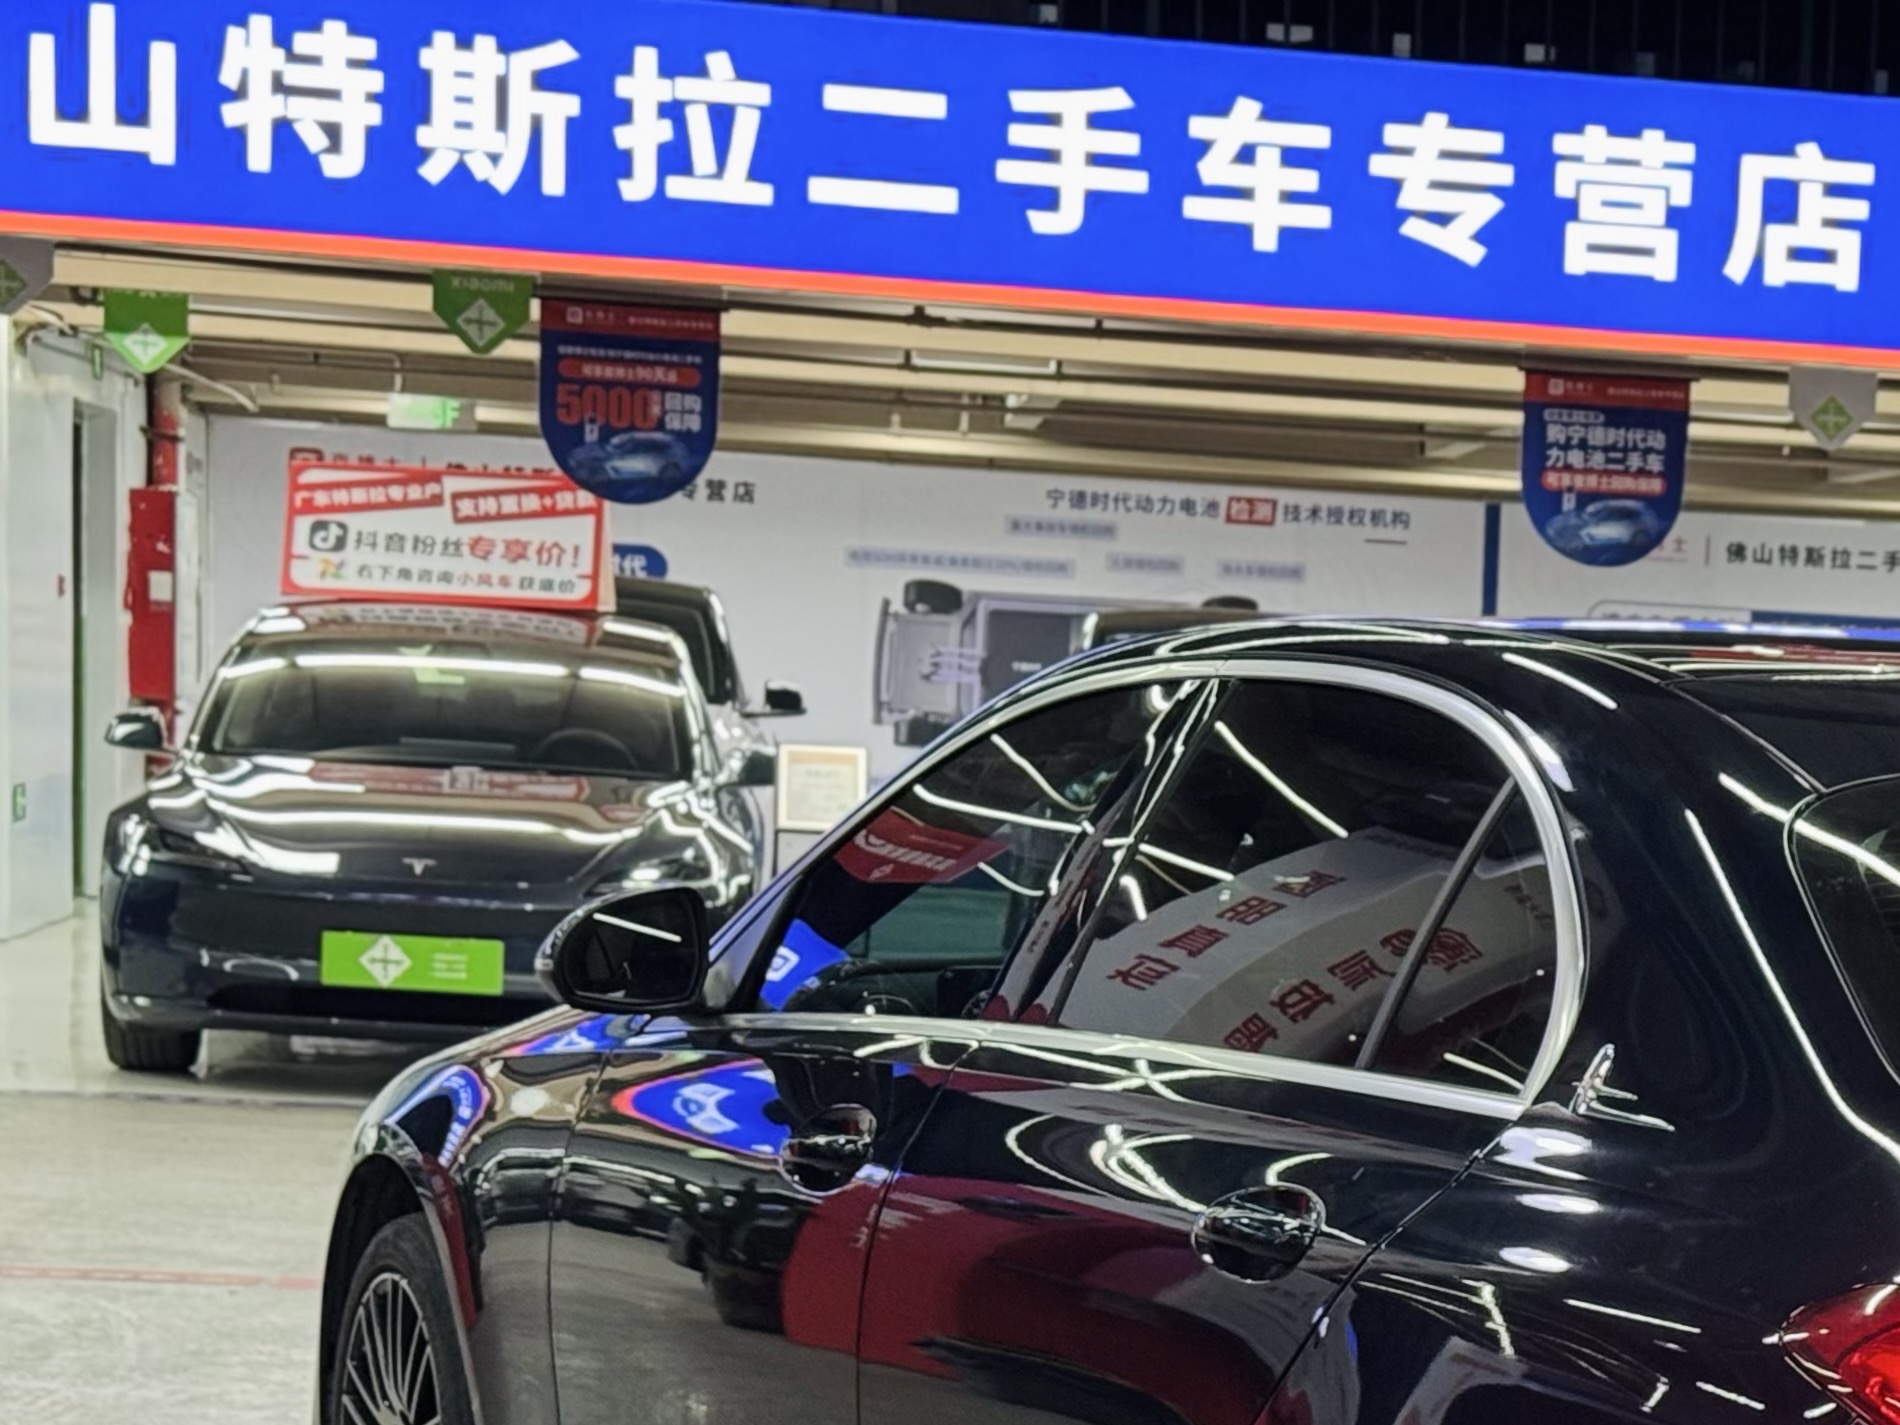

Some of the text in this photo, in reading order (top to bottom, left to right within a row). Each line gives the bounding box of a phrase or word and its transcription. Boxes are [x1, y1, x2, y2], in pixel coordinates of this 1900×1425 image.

[28, 3, 1876, 292] 山特斯拉二手车专营店
[1045, 487, 1411, 531] 宁德时代动力电池 检测 技术授权机构
